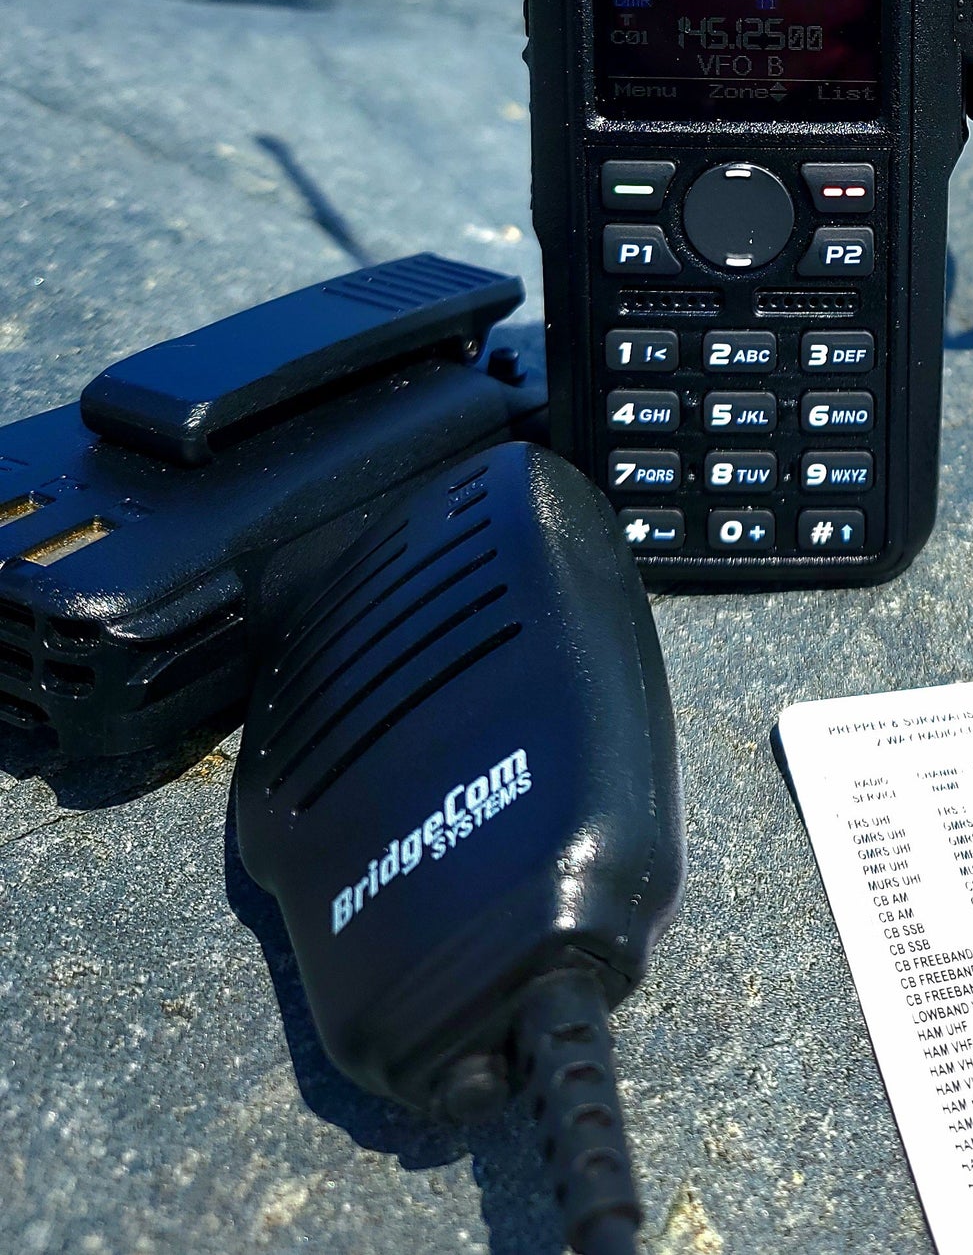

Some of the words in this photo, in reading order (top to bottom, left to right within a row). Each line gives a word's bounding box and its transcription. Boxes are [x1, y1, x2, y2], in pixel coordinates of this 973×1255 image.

[697, 54, 753, 77] VFO
[767, 55, 785, 77] B
[613, 82, 678, 99] Menu
[708, 83, 770, 100] Zone
[817, 84, 877, 102] List
[619, 244, 653, 264] P1
[825, 245, 863, 265] P2
[431, 771, 533, 861] SYSTEMS
[331, 748, 527, 936] BridgeCom
[853, 832, 884, 844] GMRS
[858, 847, 889, 860] GMRS
[863, 863, 886, 875] PMR
[868, 877, 899, 891] MURS
[873, 895, 889, 907] CB
[893, 892, 908, 904] AM
[879, 911, 894, 923] CB
[899, 908, 914, 920] AM
[884, 927, 900, 939] CB
[903, 923, 925, 936] SSB
[890, 944, 905, 956] CB
[908, 939, 931, 952] SSB
[895, 960, 911, 972] CB
[913, 949, 973, 969] FREEBAND
[901, 977, 917, 989] CB
[906, 994, 922, 1006] CB
[913, 1003, 969, 1024] LOWBAND
[917, 1026, 943, 1041] HAM
[946, 1021, 967, 1035] UHF
[923, 1044, 949, 1059] HAM
[951, 1039, 972, 1053] VHF
[930, 1062, 955, 1077] HAM
[936, 1080, 961, 1095] HAM
